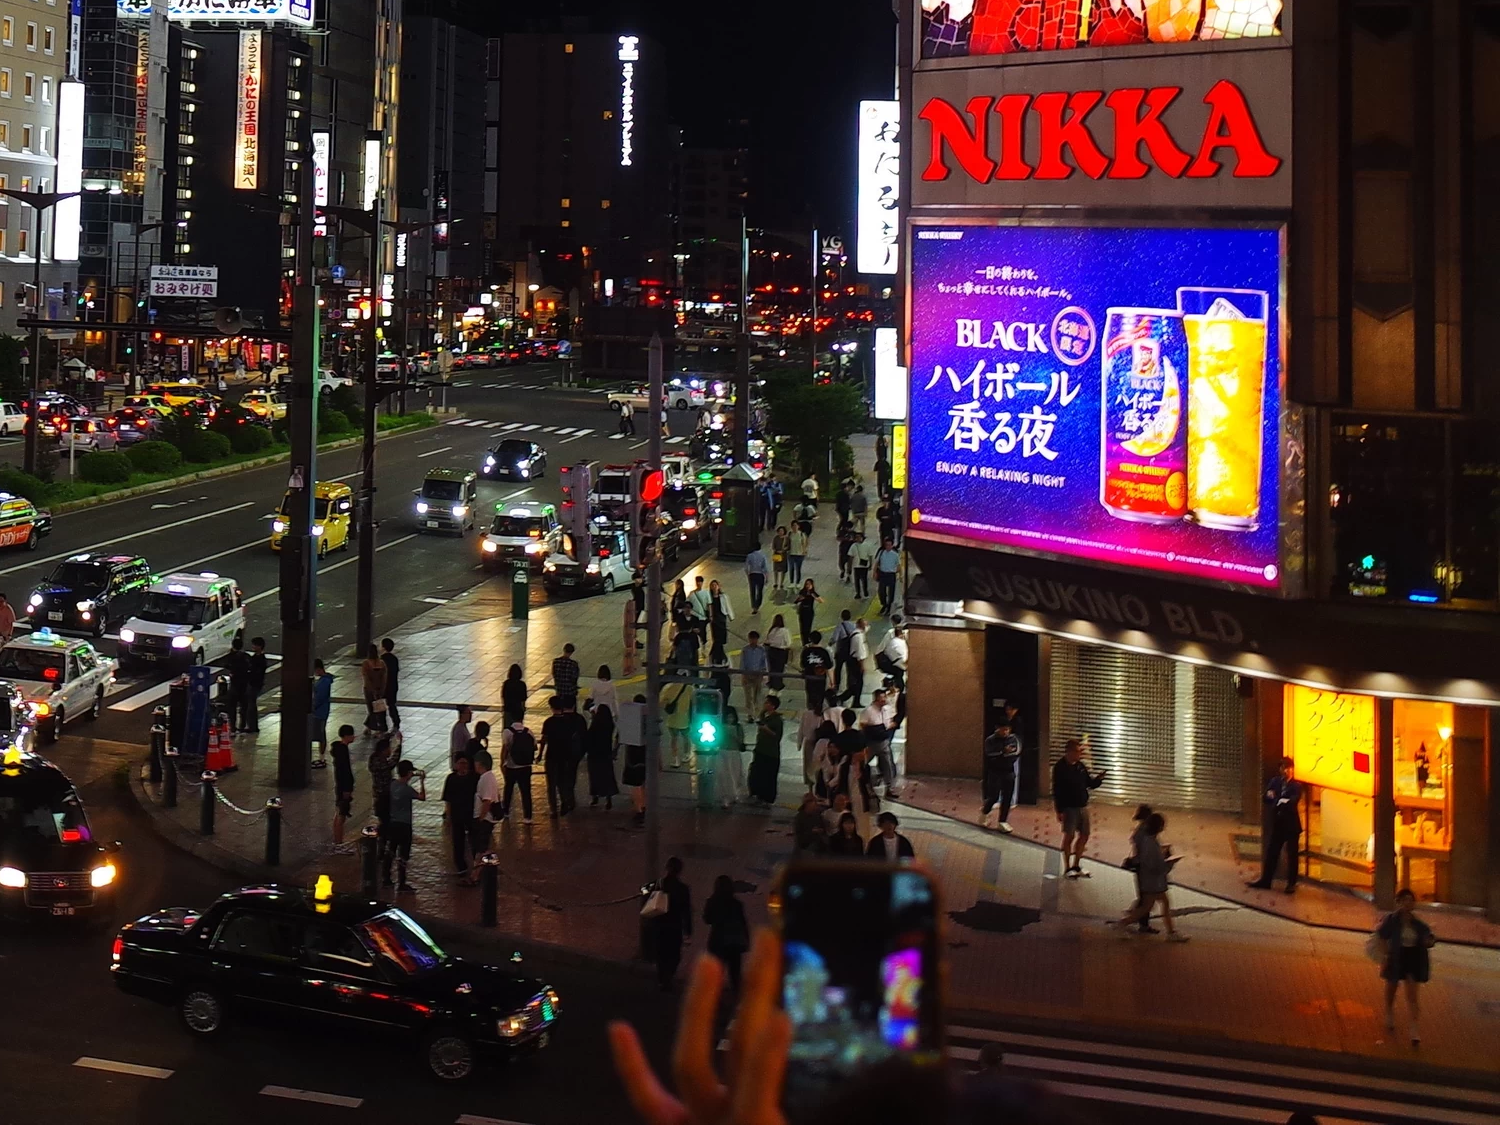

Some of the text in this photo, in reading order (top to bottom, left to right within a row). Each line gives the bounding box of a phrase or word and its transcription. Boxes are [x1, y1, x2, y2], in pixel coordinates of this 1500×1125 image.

[919, 79, 1283, 185] NIKKA
[154, 282, 214, 296] おみやげ処
[956, 318, 1050, 354] BLACK
[924, 361, 1082, 407] ハイボール
[944, 404, 1060, 462] 香る夜
[936, 461, 1066, 488] ENJOY A RELAXING NIGHT
[967, 567, 1152, 627] SUSUKINO
